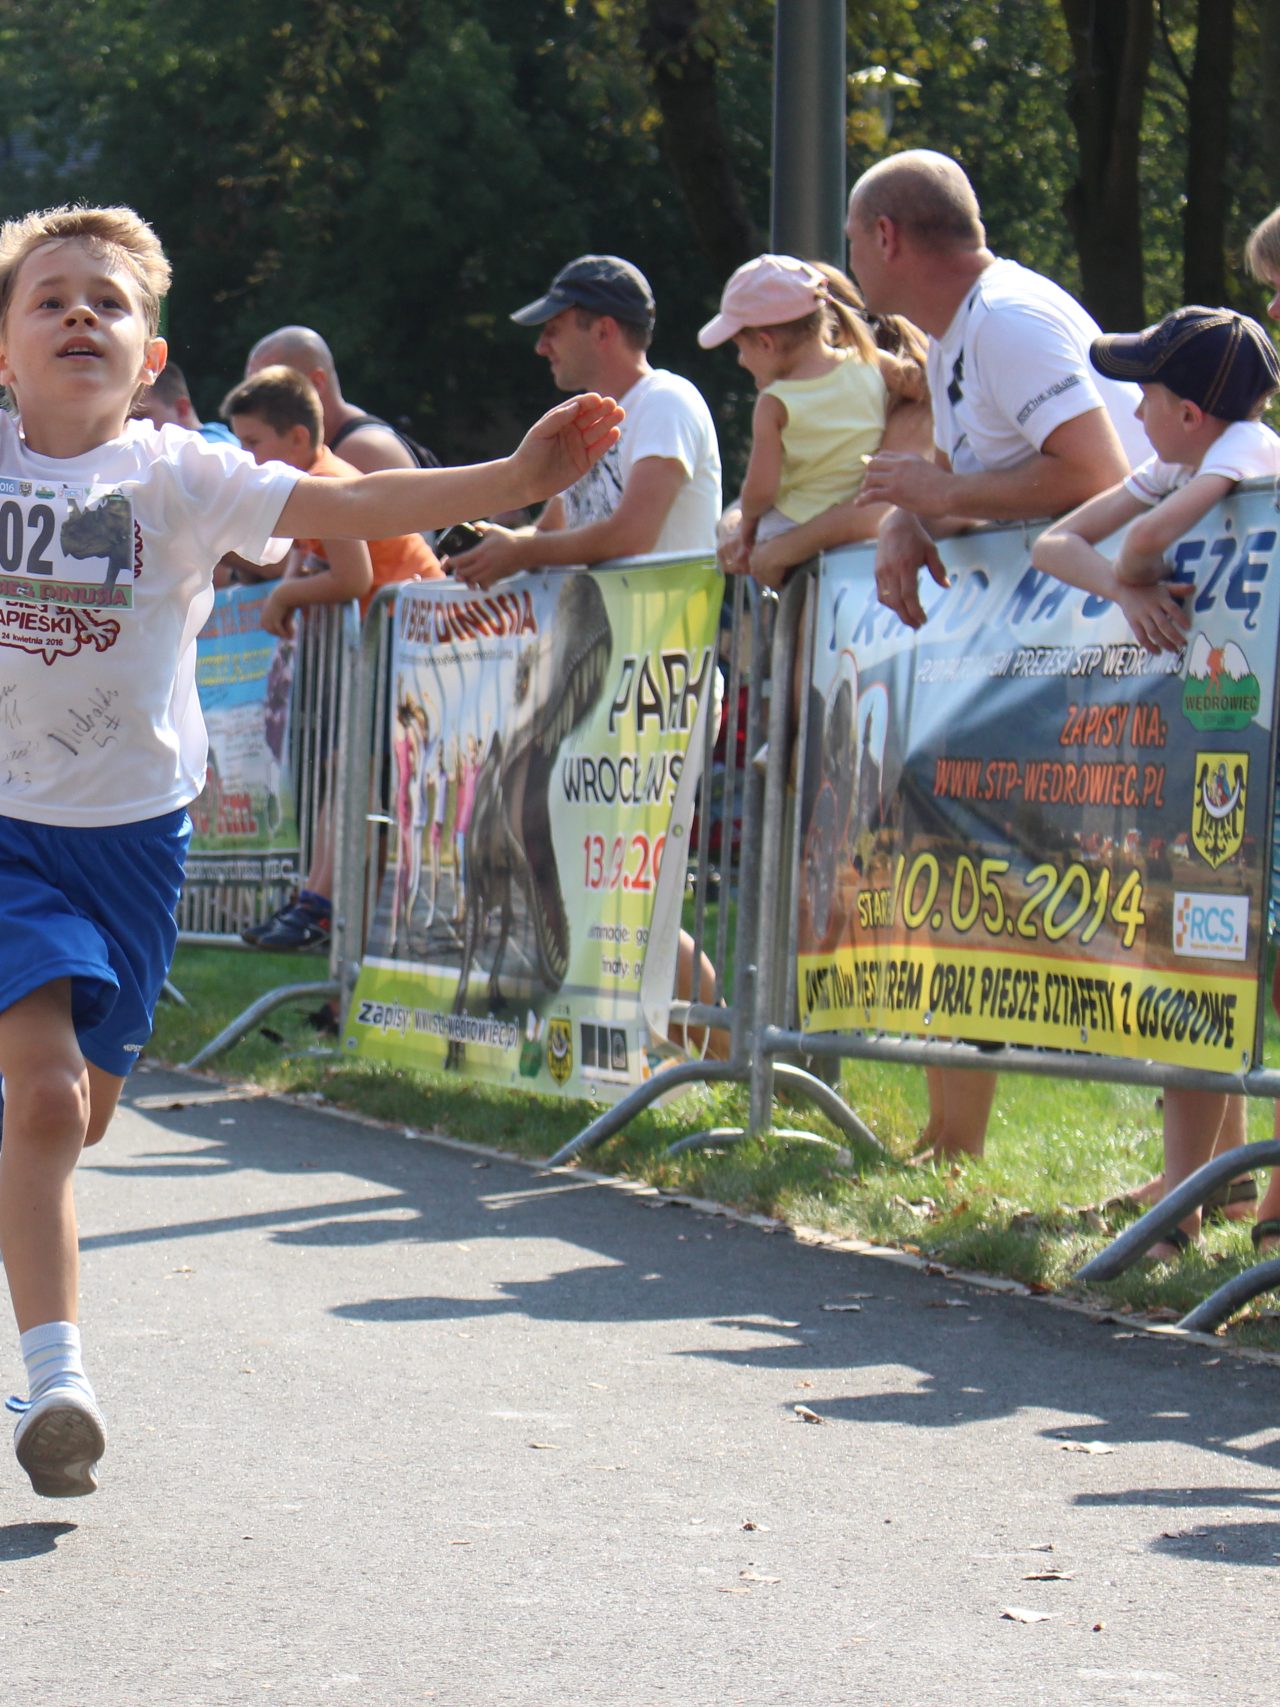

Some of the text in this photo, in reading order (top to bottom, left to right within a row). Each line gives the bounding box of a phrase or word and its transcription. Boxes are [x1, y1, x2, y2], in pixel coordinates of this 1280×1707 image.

[1, 631, 10, 640] 24
[45, 638, 64, 646] 2016
[1059, 703, 1169, 747] ZAPISY NA:
[891, 852, 1146, 948] 10.05.2014
[929, 962, 976, 1017] ORAZ
[980, 966, 1040, 1023] PIESZE
[1043, 971, 1116, 1033] SZTAFETY
[1136, 984, 1238, 1049] OSOBOWE
